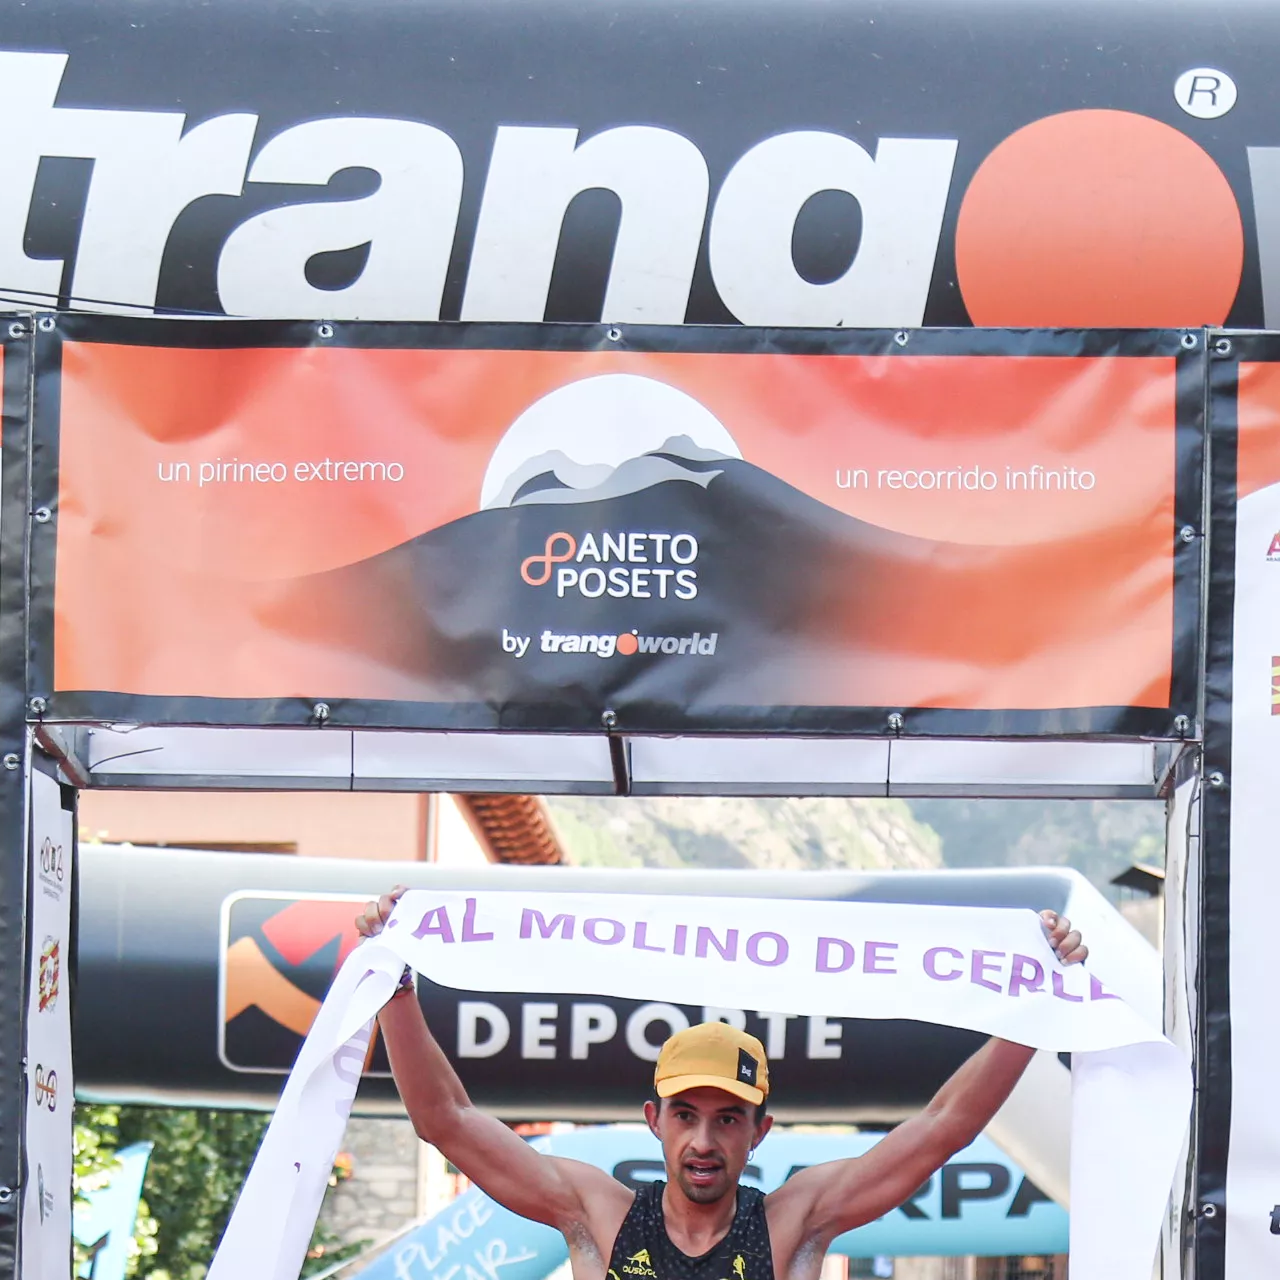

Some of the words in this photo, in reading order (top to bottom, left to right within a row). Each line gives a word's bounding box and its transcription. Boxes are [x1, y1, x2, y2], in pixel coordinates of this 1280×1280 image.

[158, 461, 190, 482] un
[199, 457, 288, 487] pirineo
[294, 458, 404, 482] extremo
[836, 468, 868, 489] un
[878, 465, 998, 490] recorrido
[1005, 465, 1096, 490] infinito
[576, 532, 699, 564] ANETO
[557, 567, 698, 600] POSETS
[502, 629, 530, 657] by
[411, 898, 494, 943] AL
[519, 907, 790, 968] MOLINO
[815, 936, 899, 975] DE
[457, 1002, 843, 1061] DEPORTE
